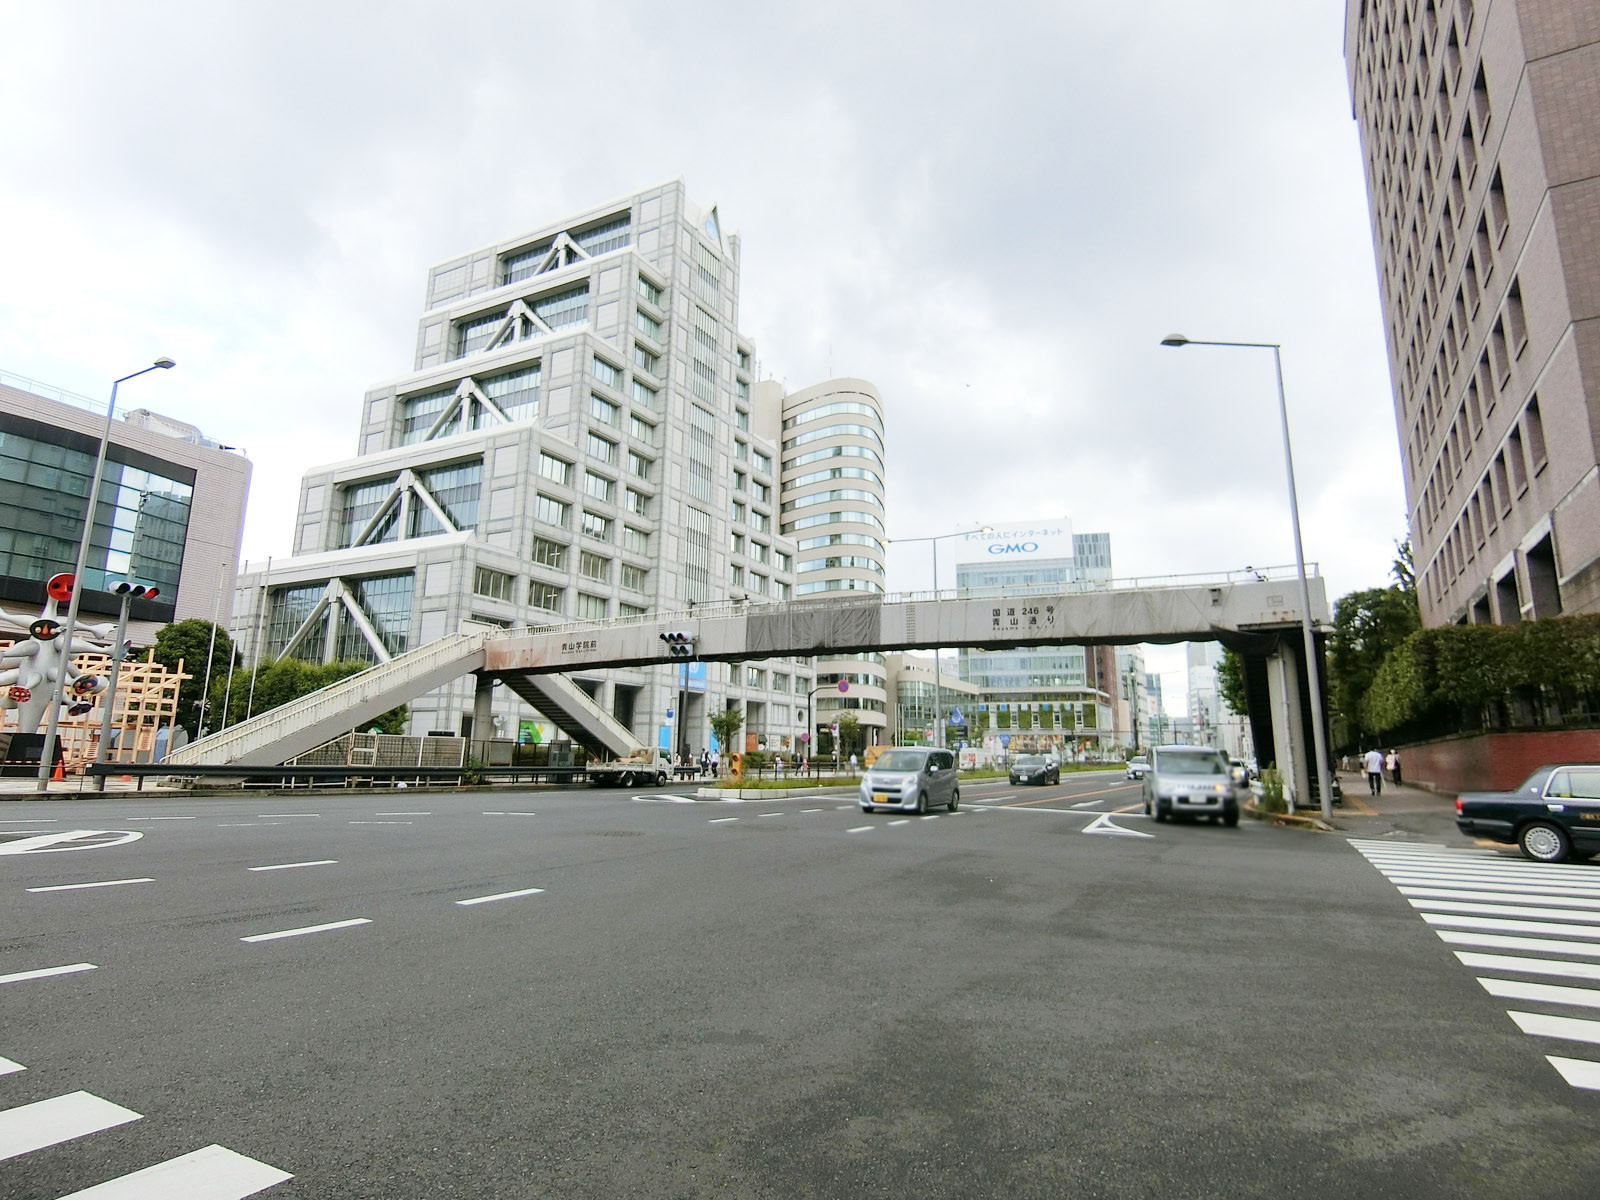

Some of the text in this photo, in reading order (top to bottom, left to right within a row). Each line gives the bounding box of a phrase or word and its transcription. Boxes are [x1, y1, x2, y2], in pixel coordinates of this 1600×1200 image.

[964, 528, 1063, 541] すべての人にインターネット
[988, 542, 1038, 554] GMO
[992, 615, 1054, 625] 青山通り
[562, 640, 596, 650] 青山学院前
